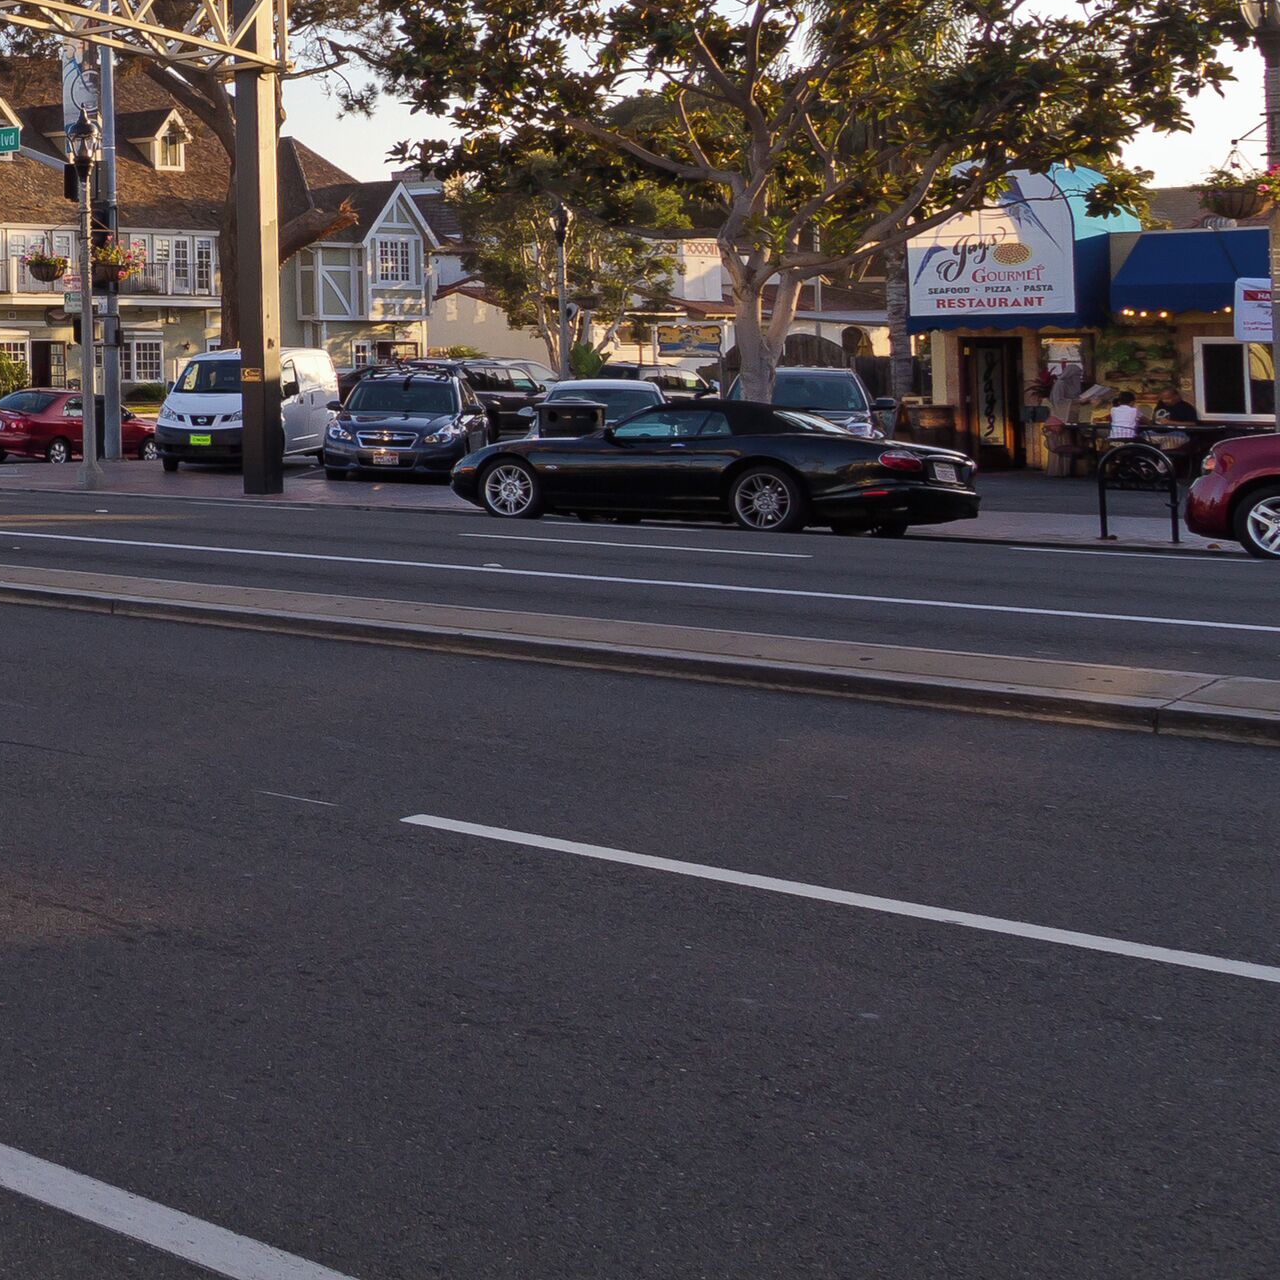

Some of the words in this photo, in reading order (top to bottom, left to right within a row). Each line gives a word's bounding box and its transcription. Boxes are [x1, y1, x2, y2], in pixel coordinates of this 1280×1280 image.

[928, 286, 970, 295] SEAFOOD
[984, 285, 1012, 293] PIZZA
[1023, 284, 1053, 292] PASTA
[936, 296, 1045, 309] RESTAURANT
